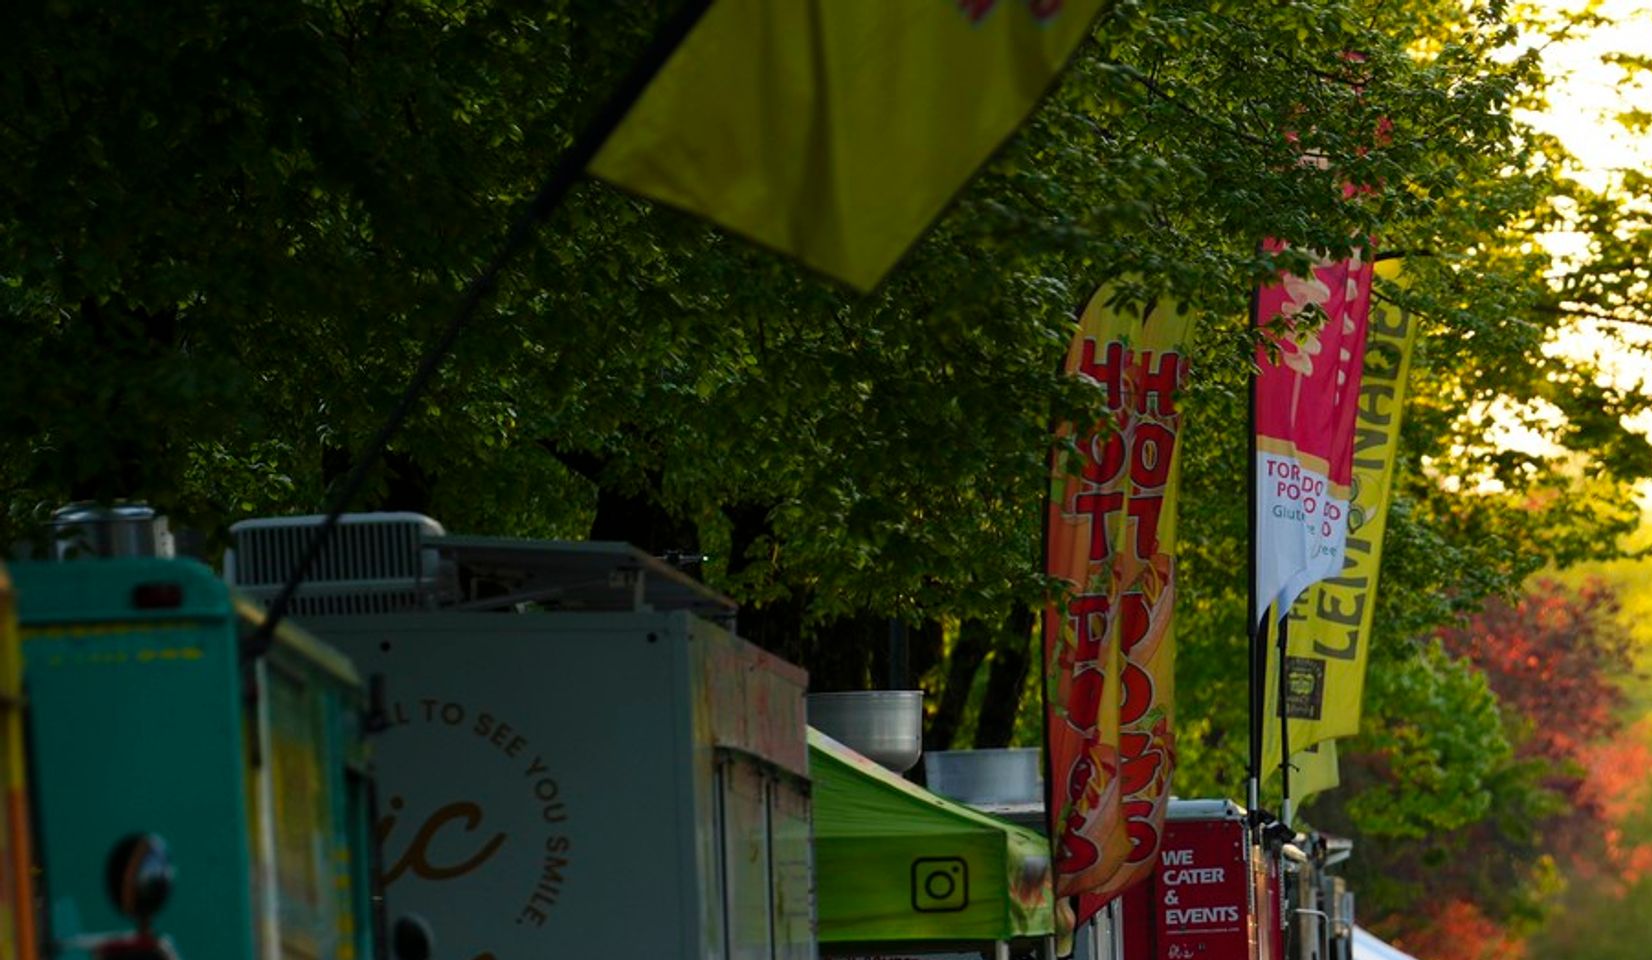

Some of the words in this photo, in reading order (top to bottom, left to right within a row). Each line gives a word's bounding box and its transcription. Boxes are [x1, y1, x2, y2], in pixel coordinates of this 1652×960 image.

[421, 698, 465, 725] TO
[472, 711, 527, 758] SEE
[524, 755, 567, 823] YOU
[1161, 850, 1194, 867] WE
[1162, 867, 1225, 886] CATER
[1163, 889, 1180, 905] &
[1165, 906, 1240, 926] EVENTS
